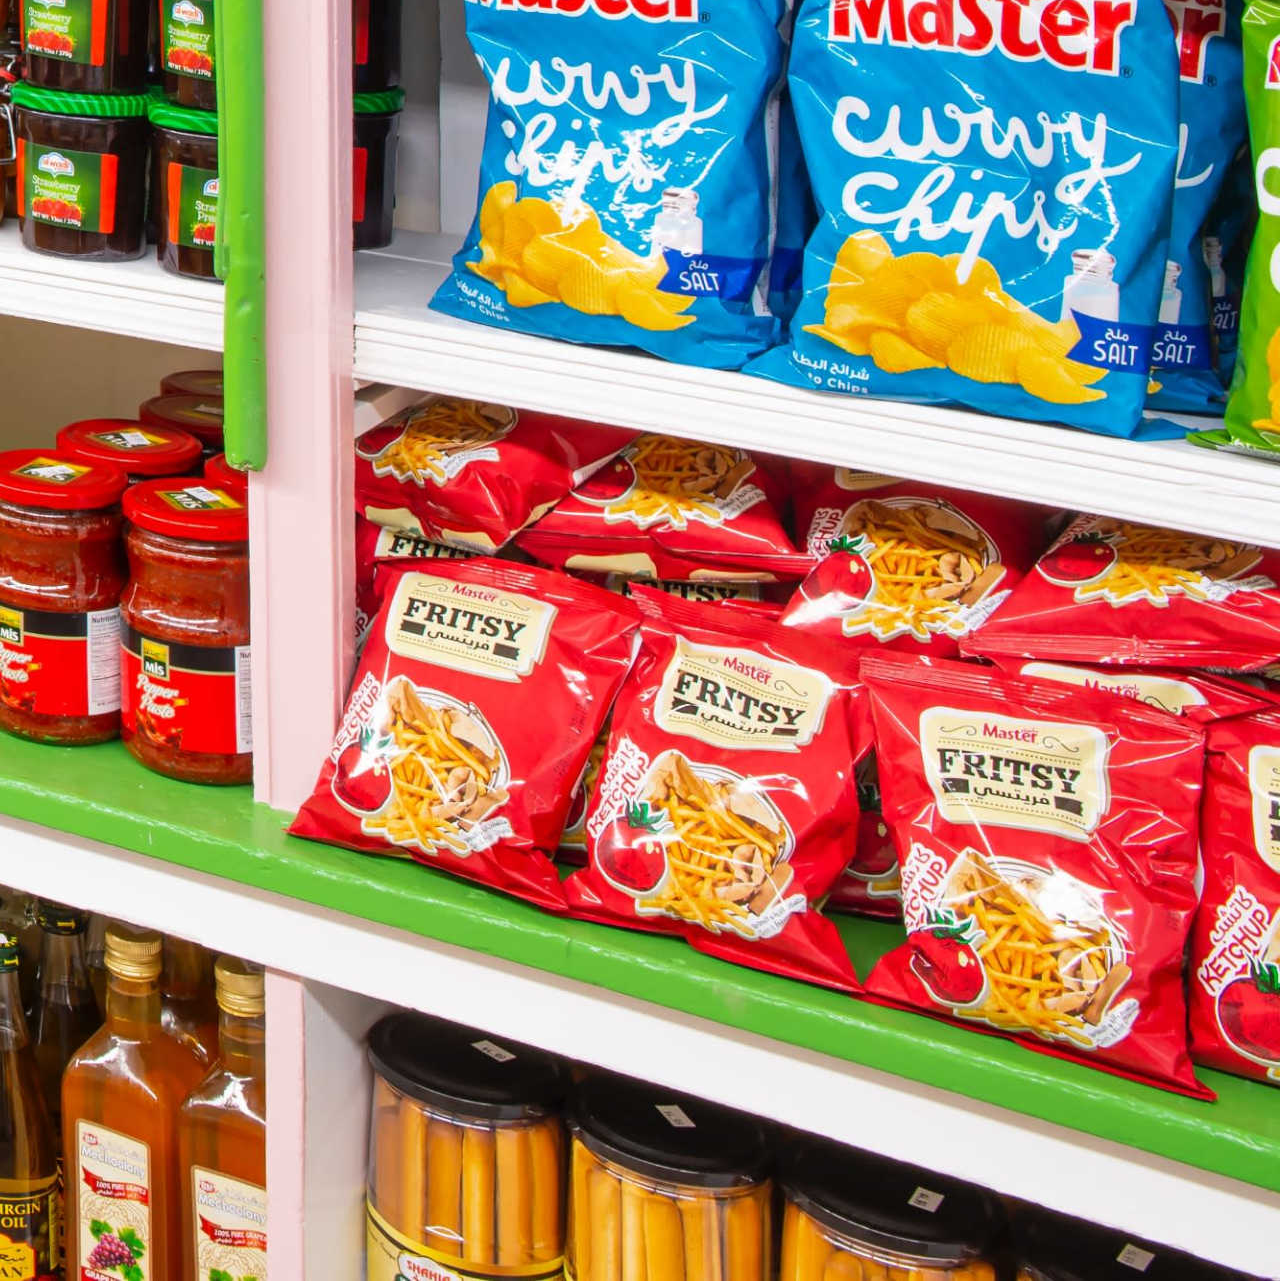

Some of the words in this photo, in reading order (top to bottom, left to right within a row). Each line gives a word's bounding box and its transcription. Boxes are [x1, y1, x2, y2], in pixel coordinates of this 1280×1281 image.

[28, 6, 71, 24] Strawberry
[168, 24, 210, 44] Strawberry
[832, 95, 1143, 204] curvy
[32, 175, 81, 194] Strawberry
[679, 271, 720, 293] SALT
[1093, 342, 1138, 368] SALT
[1151, 340, 1196, 365] SALT
[452, 582, 499, 603] Master
[403, 597, 526, 643] FRITSY
[723, 654, 771, 687] Master
[137, 674, 179, 699] Pepper
[140, 694, 175, 718] Paste
[672, 673, 807, 727] FRITSY
[982, 722, 1038, 744] Master
[937, 748, 1081, 795] FRITSY
[1199, 909, 1268, 994] KETCHUP
[0, 1215, 28, 1229] OIL
